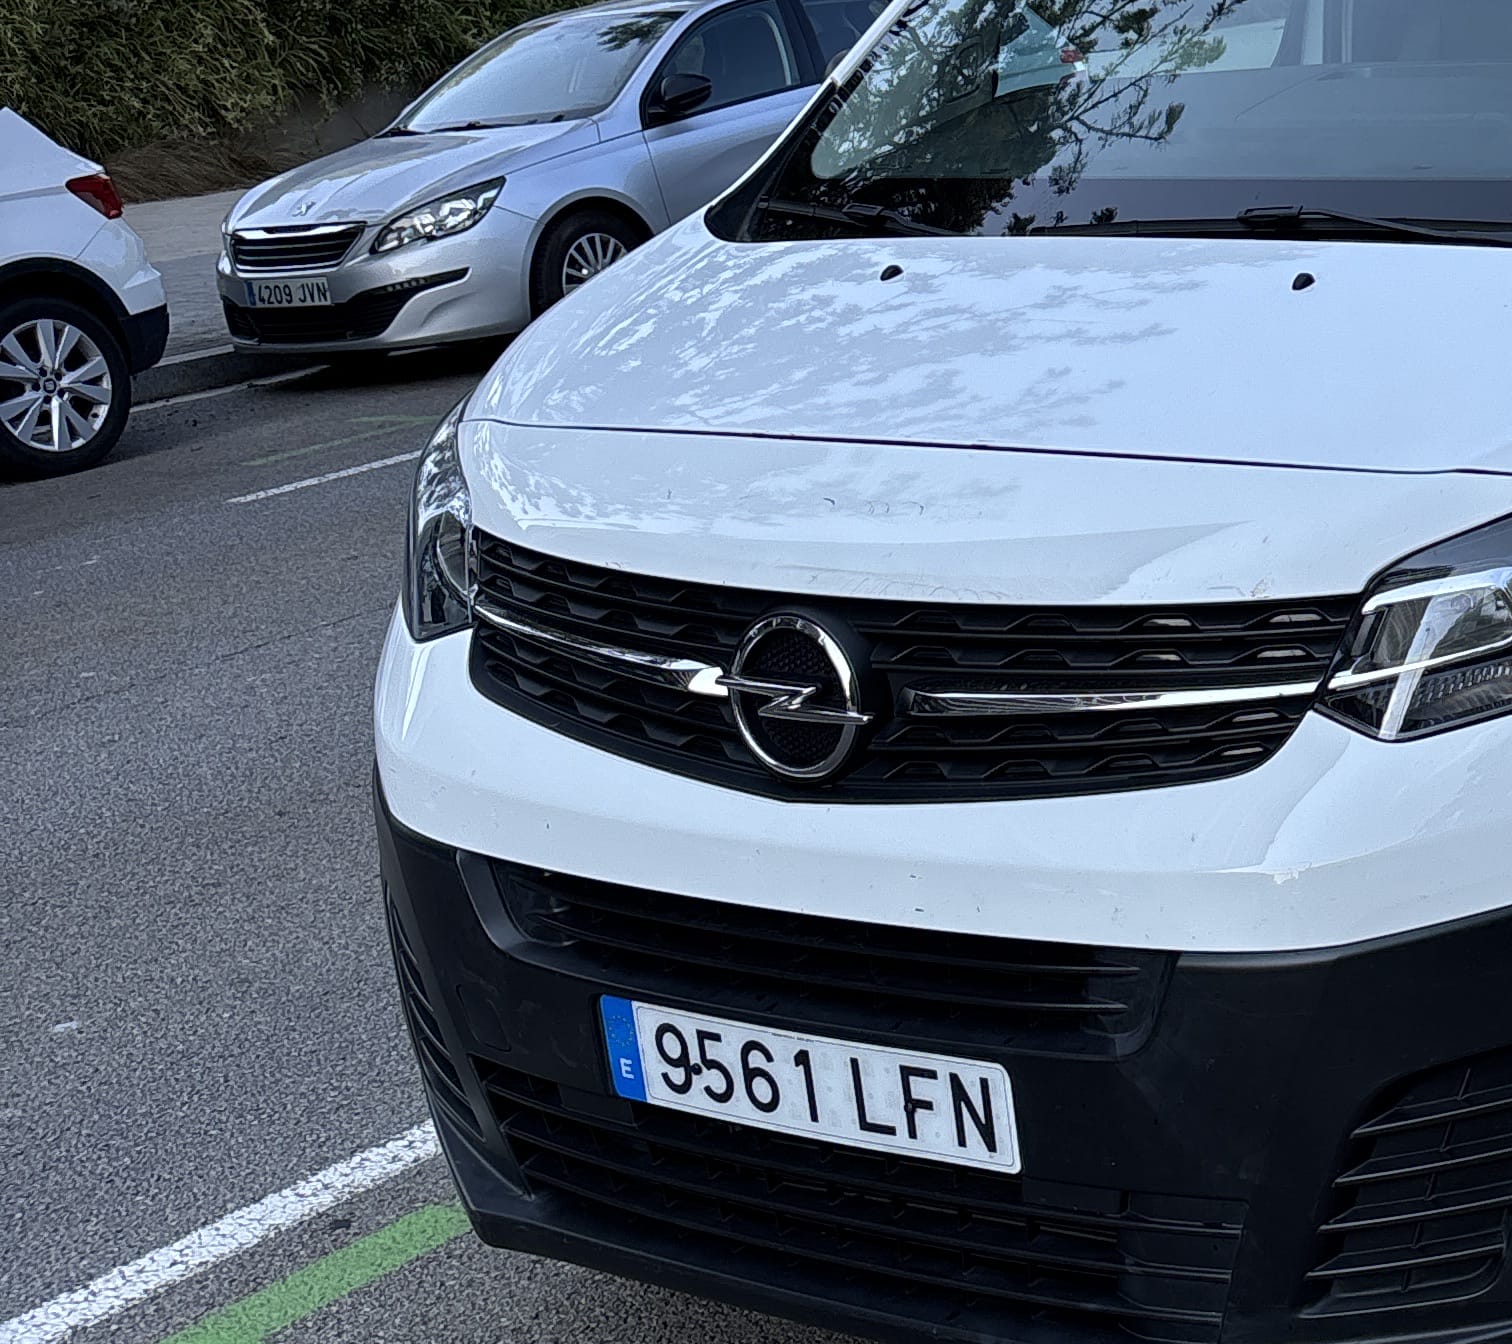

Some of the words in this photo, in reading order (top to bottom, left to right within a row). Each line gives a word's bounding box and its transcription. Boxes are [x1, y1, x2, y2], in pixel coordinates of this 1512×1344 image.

[258, 284, 293, 305] 4209
[298, 282, 329, 304] JVN
[619, 1057, 635, 1080] E
[655, 1022, 820, 1123] 9561
[849, 1056, 998, 1154] LFN
